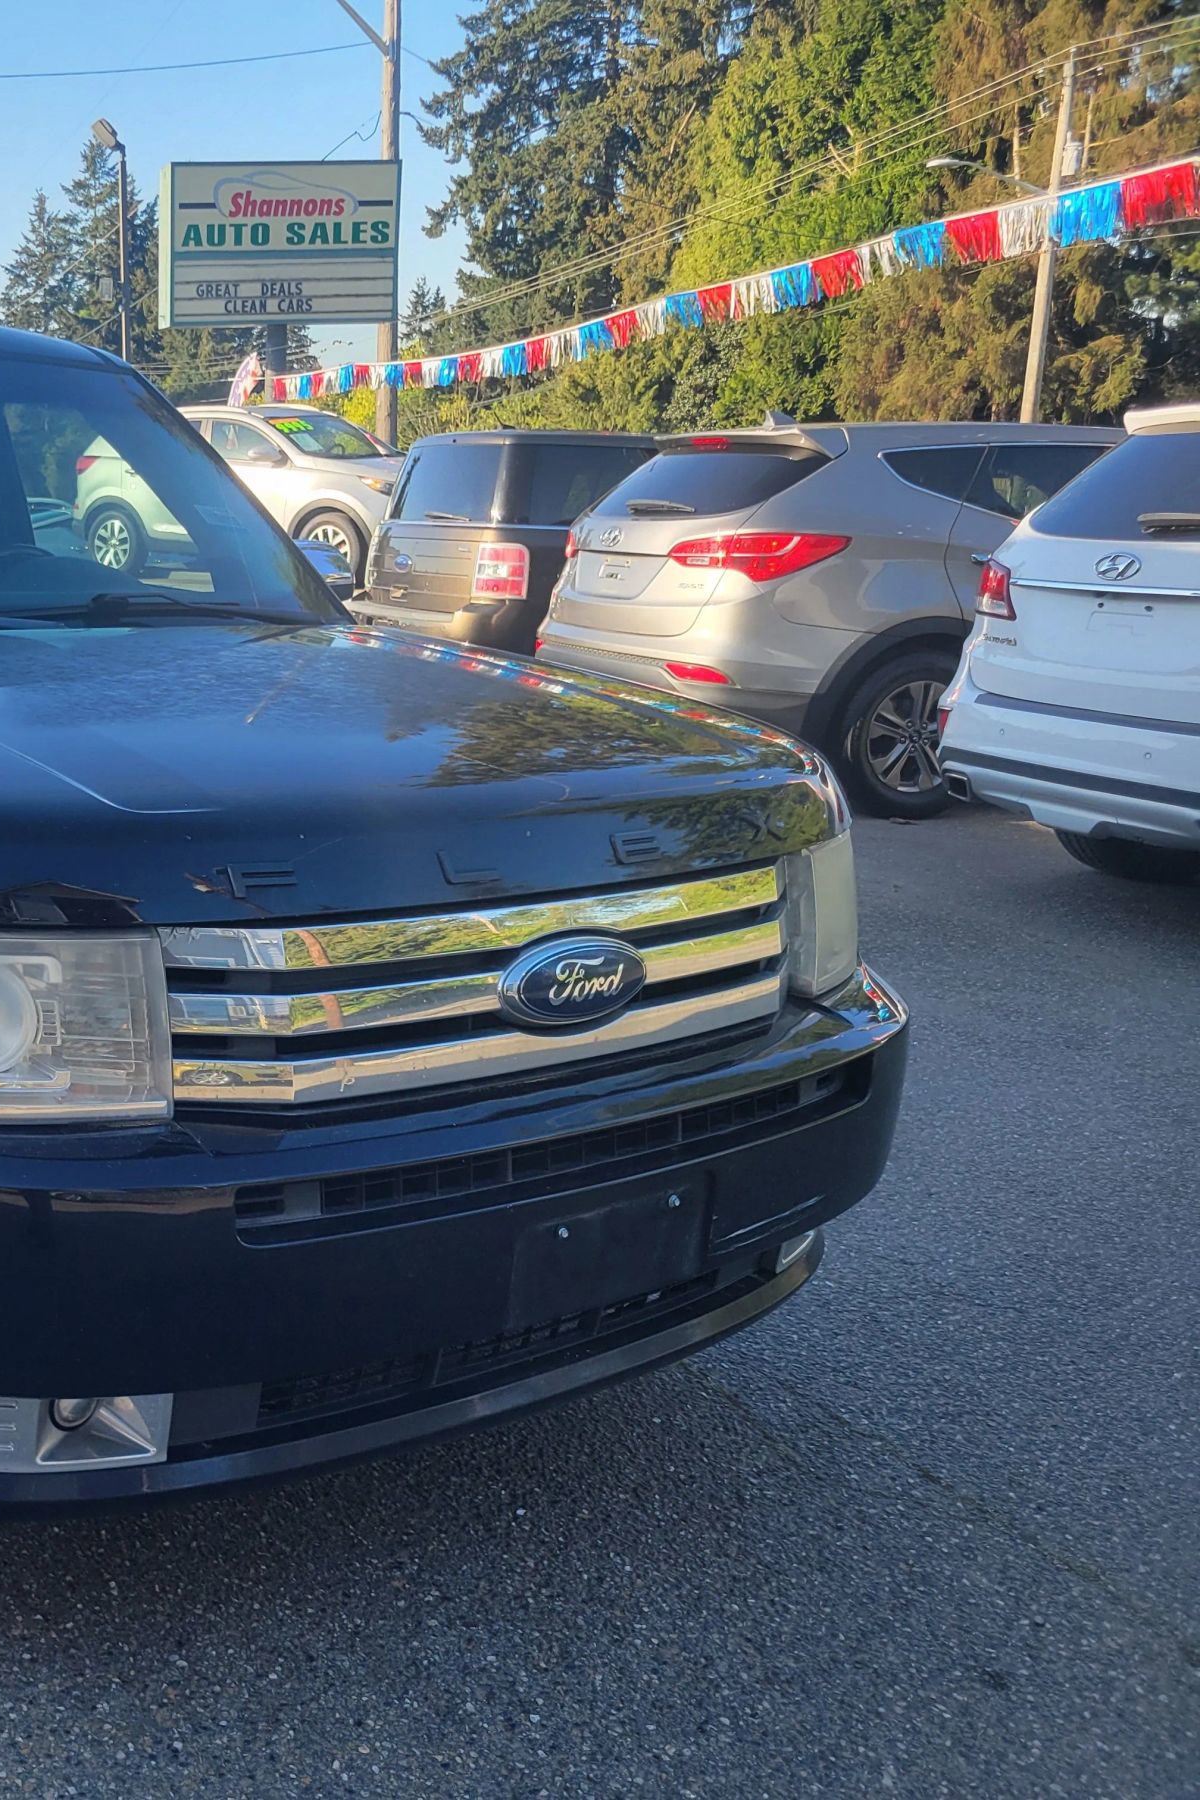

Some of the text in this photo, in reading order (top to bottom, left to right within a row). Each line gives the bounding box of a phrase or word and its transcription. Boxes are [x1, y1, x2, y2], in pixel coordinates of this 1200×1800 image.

[229, 190, 345, 218] Shannons
[182, 220, 390, 247] AUTO SALES
[196, 281, 303, 298] GREAT DEALS
[224, 297, 313, 313] CLEAN CARS
[548, 955, 624, 1006] Ford
